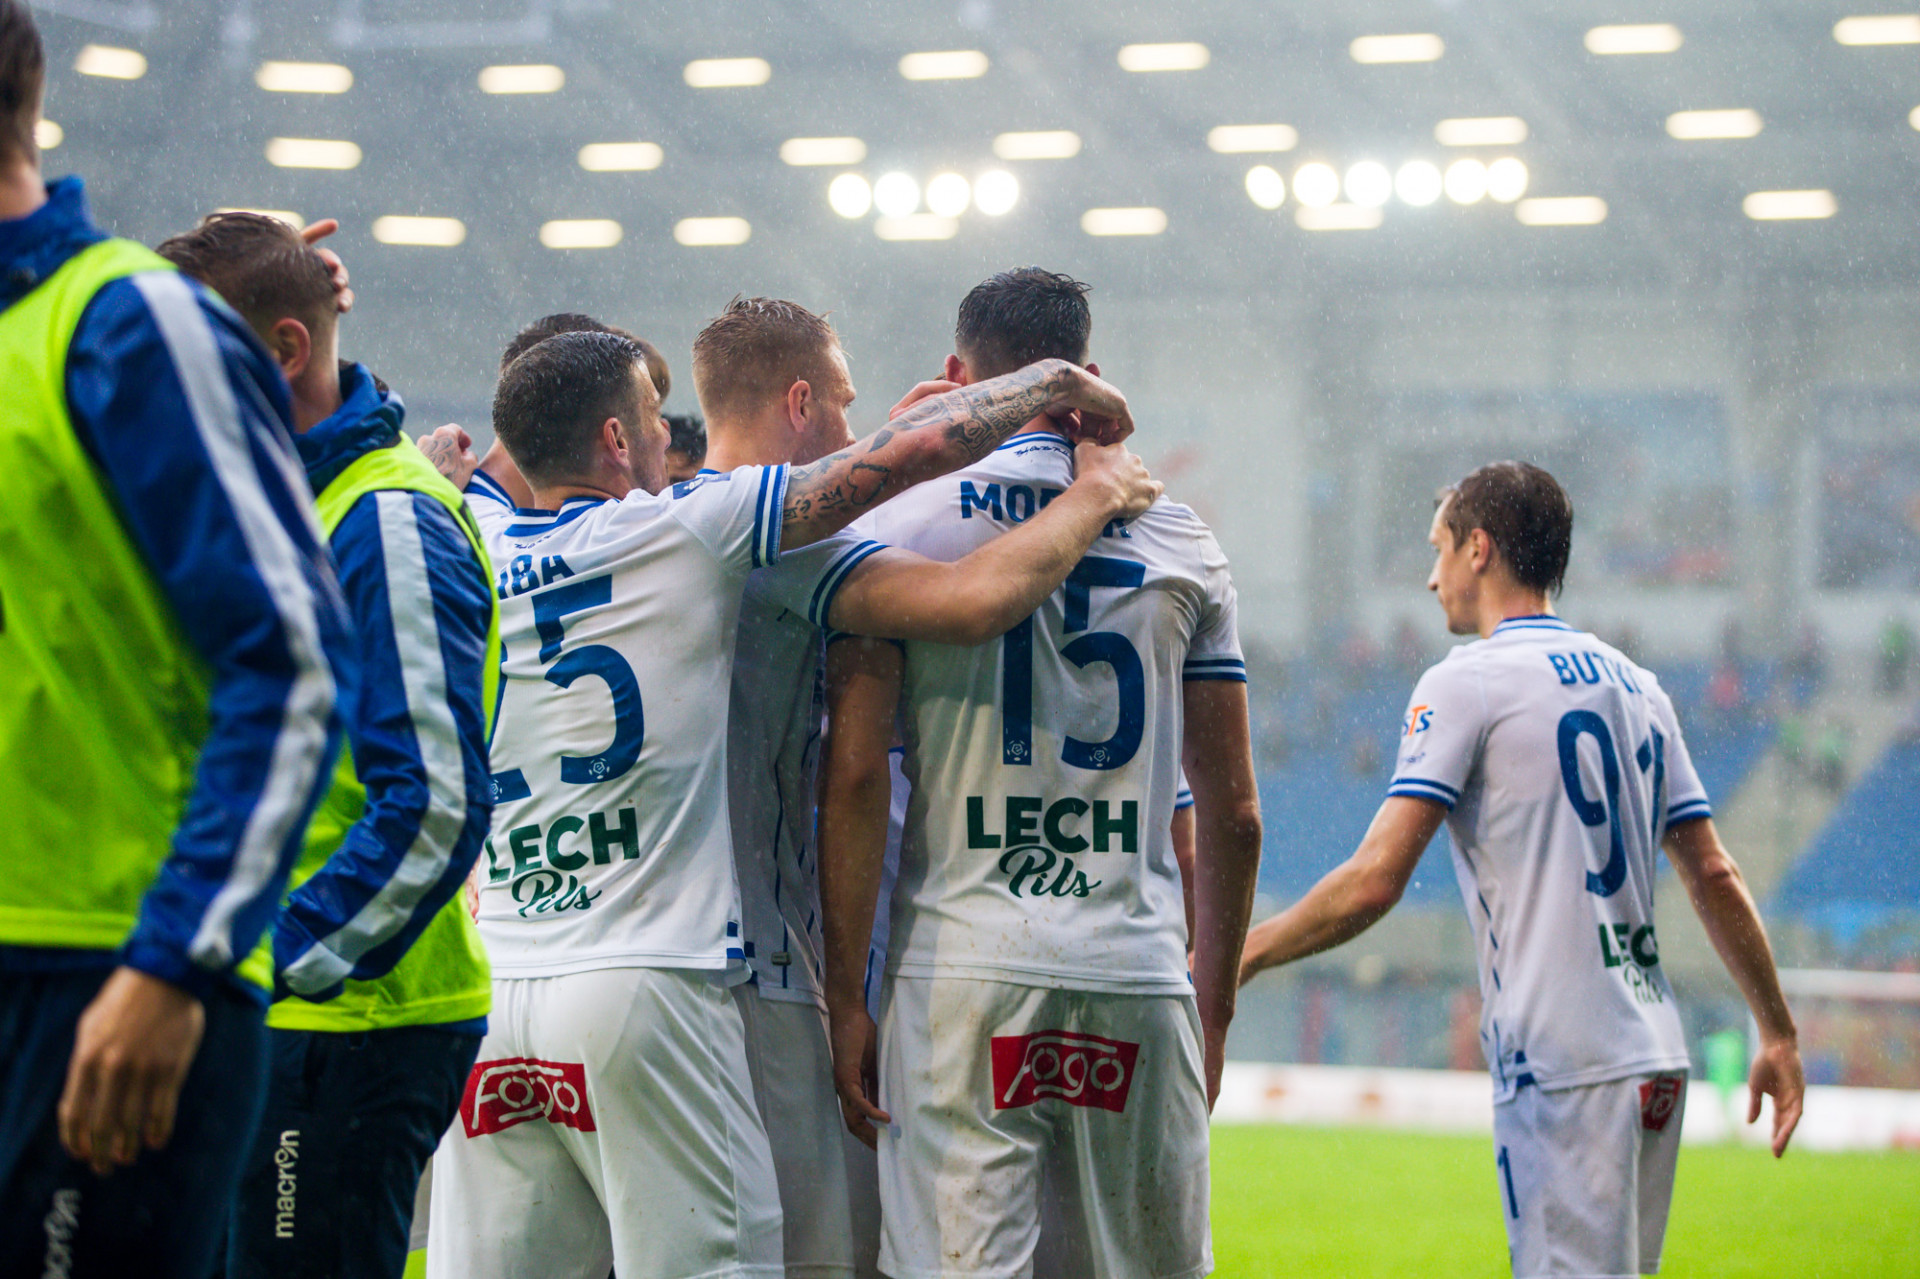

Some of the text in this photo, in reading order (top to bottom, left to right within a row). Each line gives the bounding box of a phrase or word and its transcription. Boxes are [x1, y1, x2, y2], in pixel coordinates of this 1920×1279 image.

[1003, 556, 1146, 770] 15
[484, 807, 640, 884] LECH
[967, 796, 1138, 853] LECH
[1557, 709, 1665, 907] 91
[511, 869, 602, 918] Pils
[998, 845, 1102, 899] Pils
[274, 1129, 301, 1238] macron
